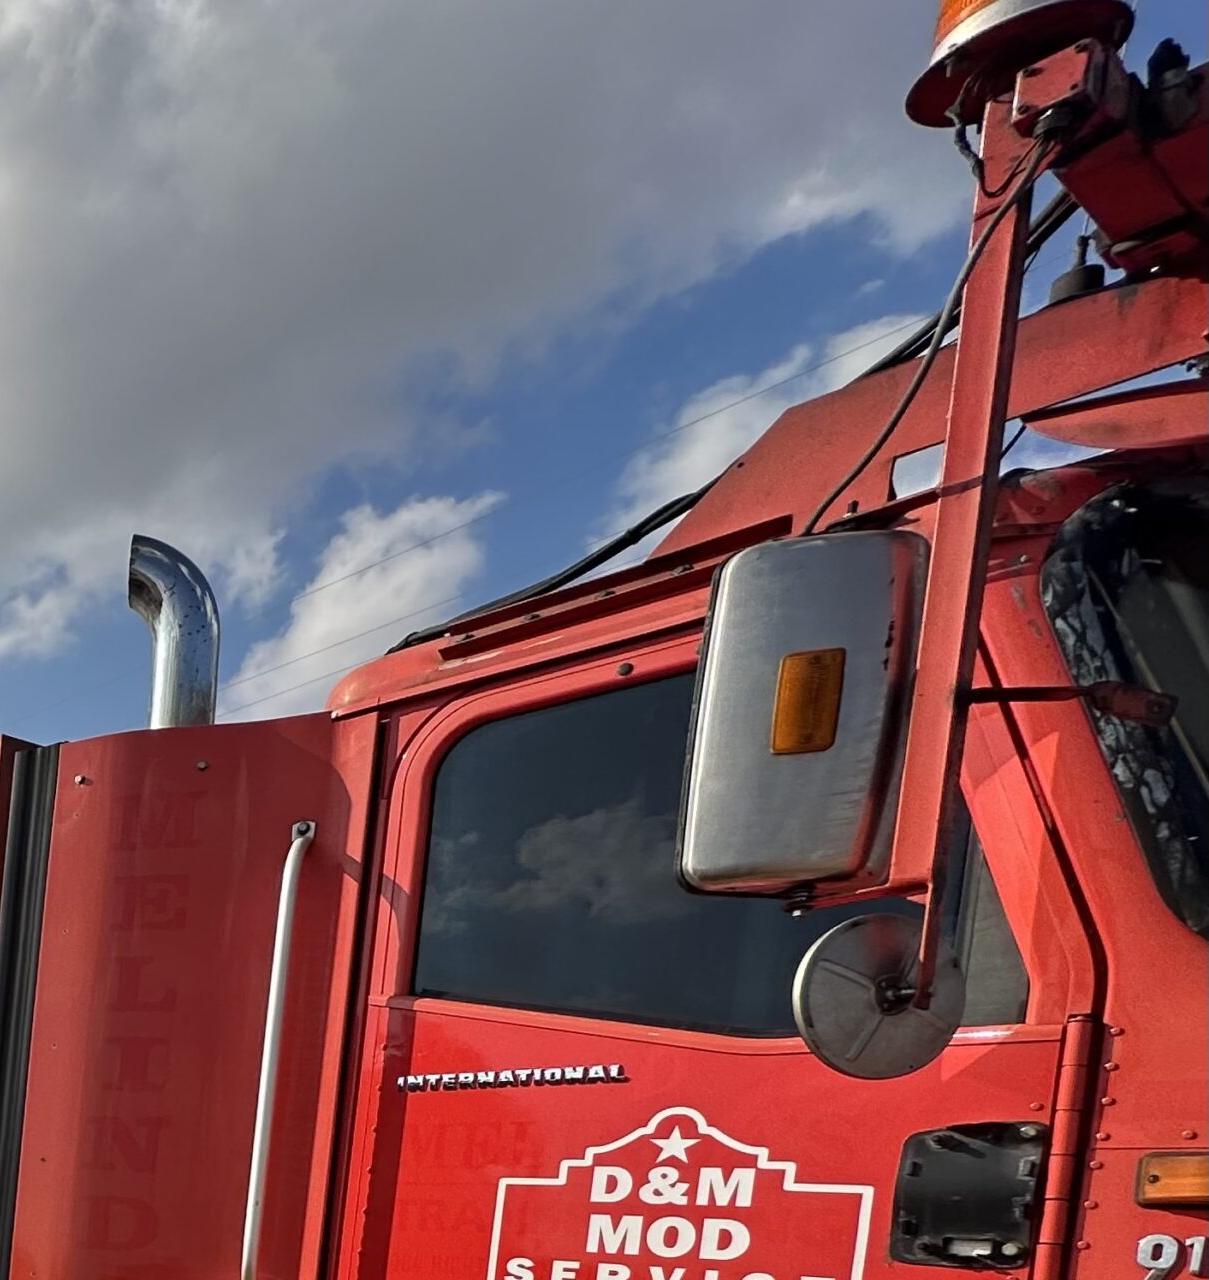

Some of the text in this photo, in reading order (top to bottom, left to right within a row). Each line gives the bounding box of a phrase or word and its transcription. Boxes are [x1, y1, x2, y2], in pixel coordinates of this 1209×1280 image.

[397, 1064, 627, 1091] INTERNATIONAL
[589, 1165, 757, 1208] D&M
[585, 1213, 751, 1261] MOD
